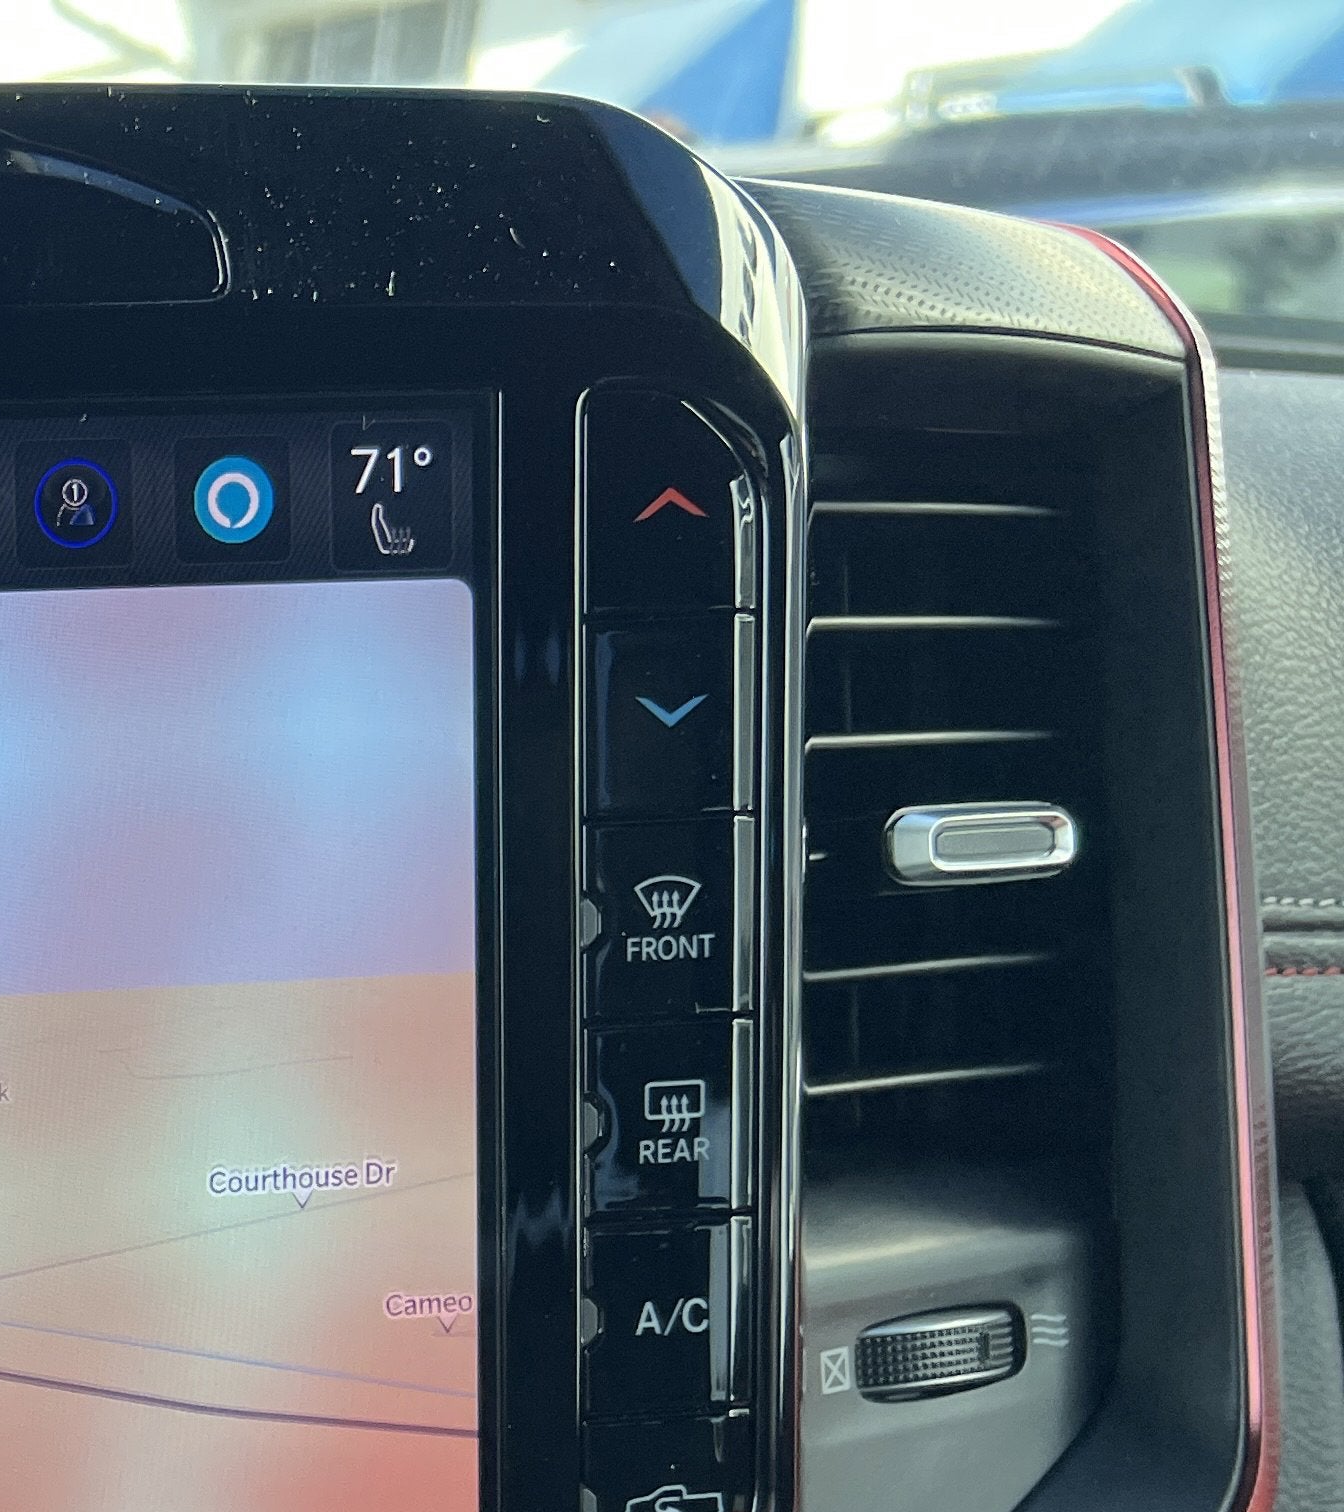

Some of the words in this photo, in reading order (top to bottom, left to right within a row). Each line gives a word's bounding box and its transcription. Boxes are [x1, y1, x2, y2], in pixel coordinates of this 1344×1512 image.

[350, 446, 433, 495] 71°
[625, 933, 716, 962] FRONT
[639, 1137, 711, 1165] REAR
[209, 1164, 359, 1196] Courthouse
[365, 1161, 396, 1187] Dr
[385, 1292, 473, 1317] Cameo
[634, 1297, 710, 1337] A/C
